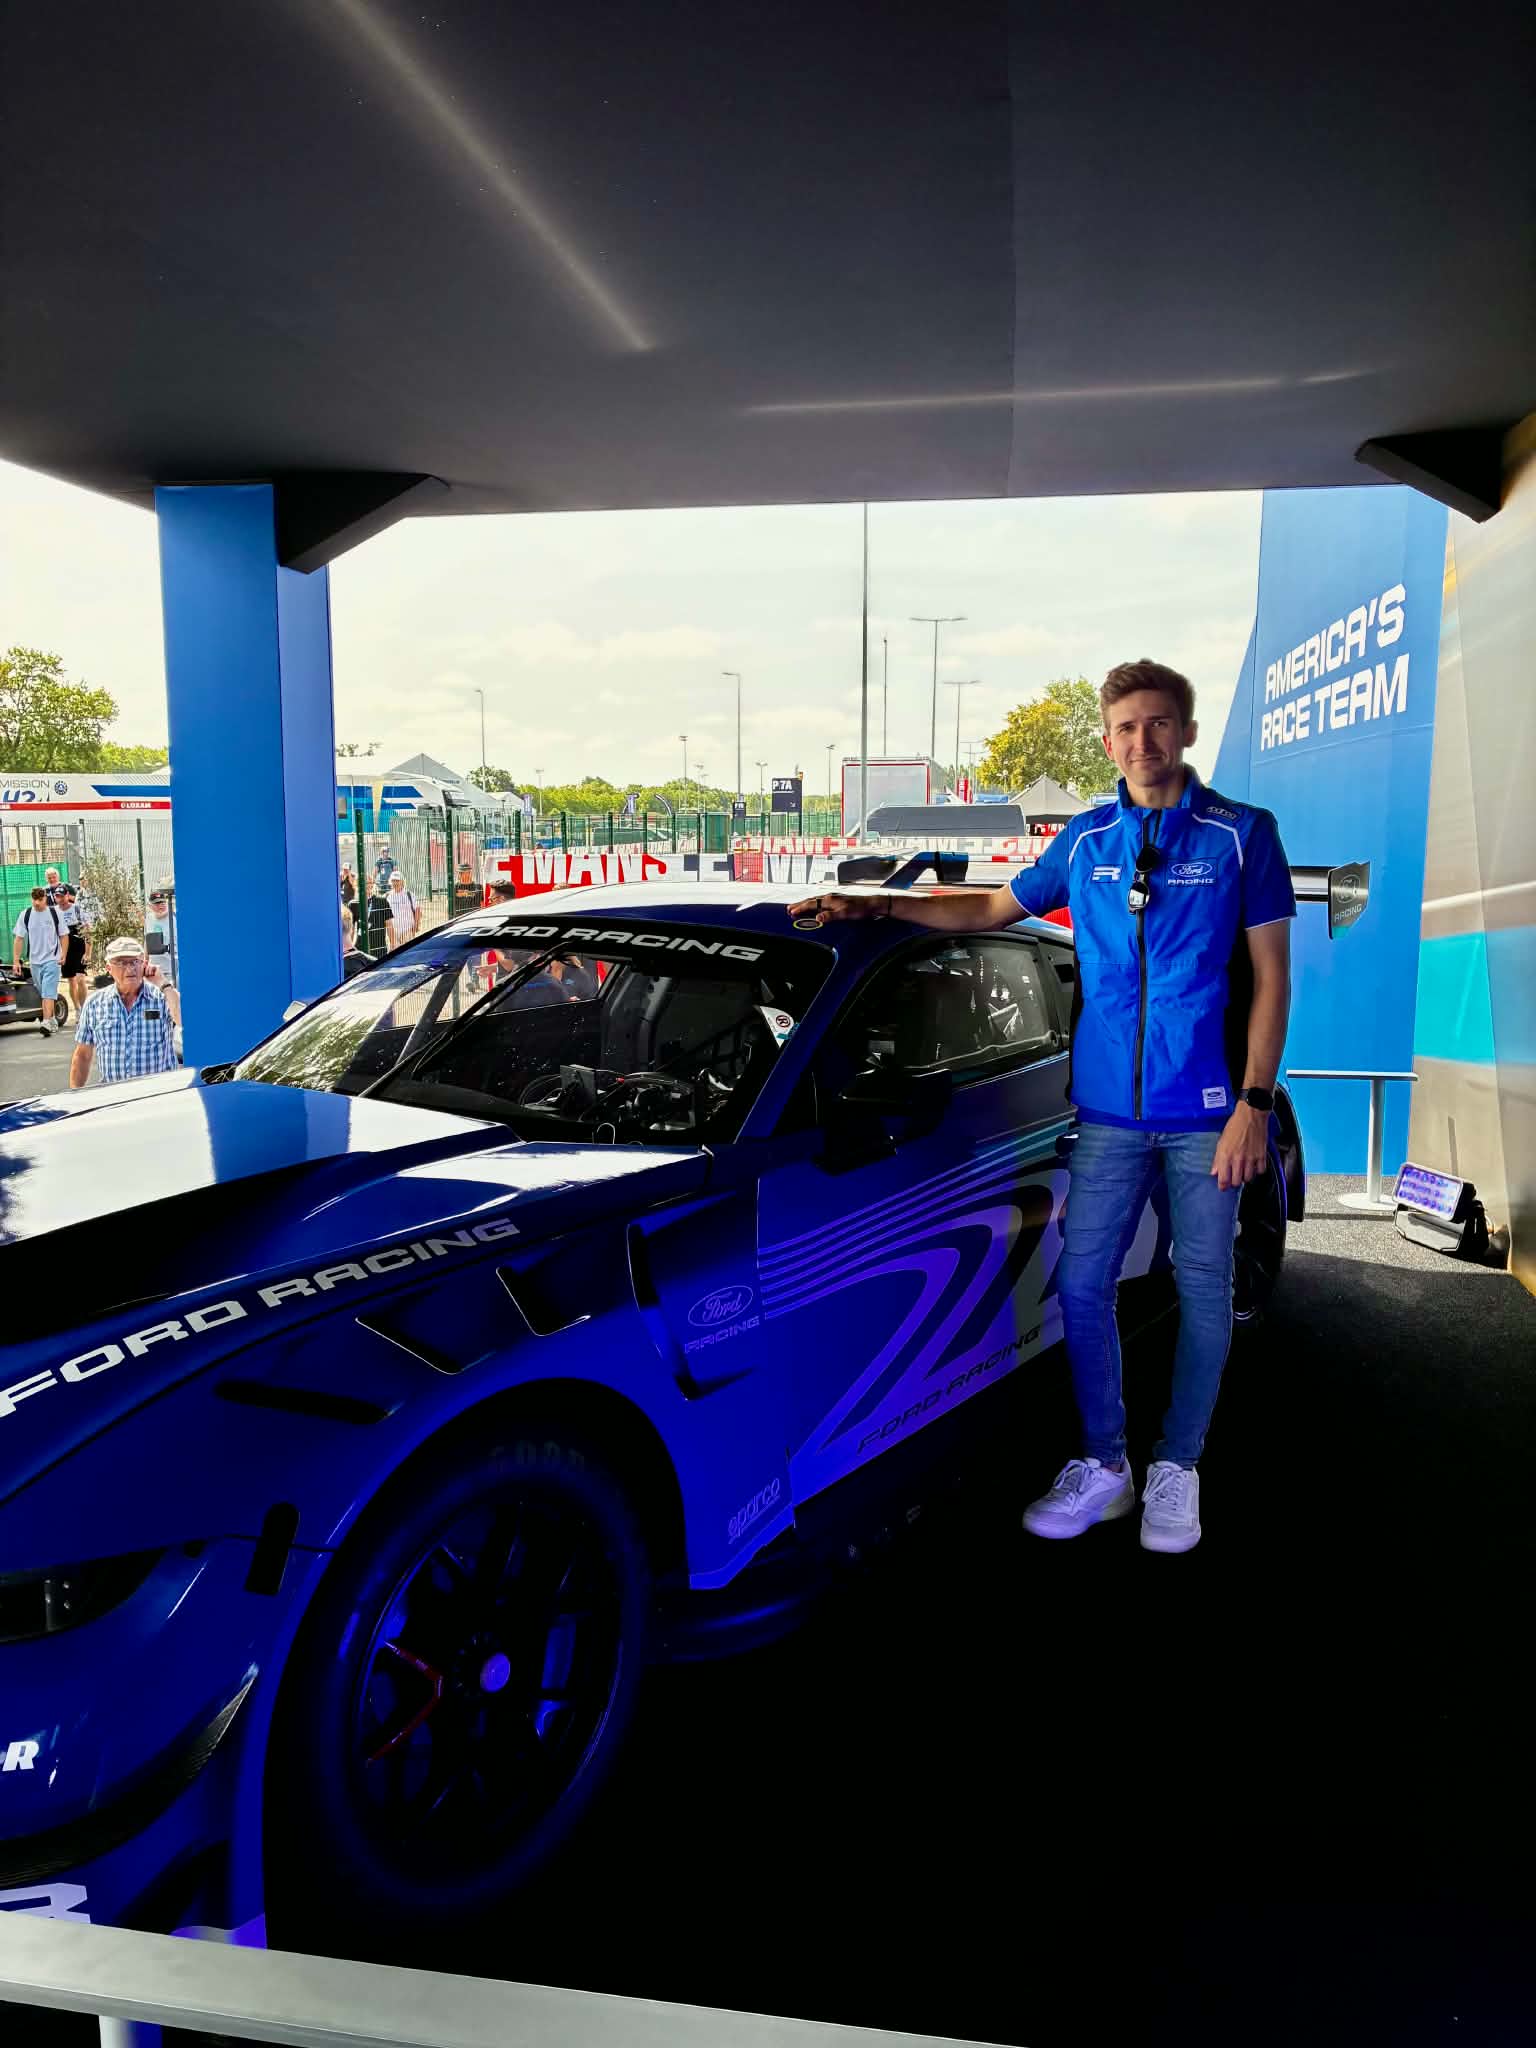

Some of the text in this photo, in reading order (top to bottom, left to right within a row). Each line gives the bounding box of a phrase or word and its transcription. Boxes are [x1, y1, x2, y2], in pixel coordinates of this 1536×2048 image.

[1264, 583, 1406, 705] AMERICA'S
[1260, 652, 1410, 752] RACE TEAM
[561, 927, 765, 962] RACING
[0, 1218, 521, 1417] FORD RACING
[684, 1315, 761, 1354] RACING
[702, 1290, 742, 1323] Ford
[856, 1326, 1041, 1455] FORD RACING
